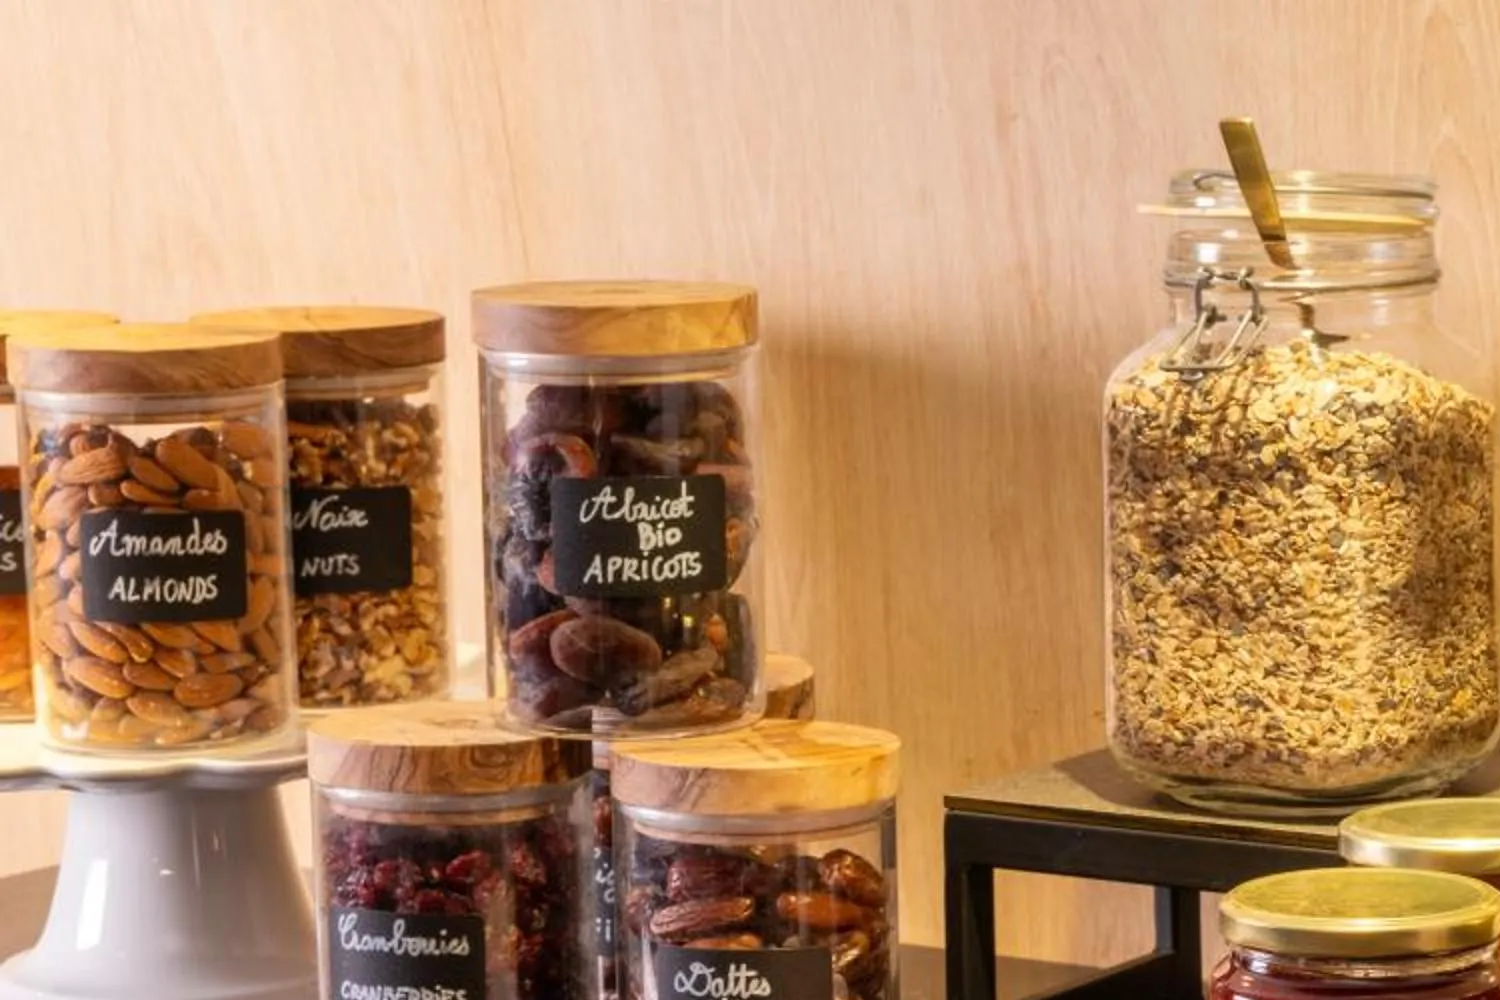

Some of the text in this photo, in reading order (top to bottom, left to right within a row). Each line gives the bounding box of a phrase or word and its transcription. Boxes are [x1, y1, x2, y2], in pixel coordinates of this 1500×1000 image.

[579, 480, 695, 523] Abricot
[89, 518, 228, 557] Amandes
[300, 553, 361, 577] NUTS
[108, 575, 219, 604] ALMONDS
[673, 962, 772, 999] Dattes
